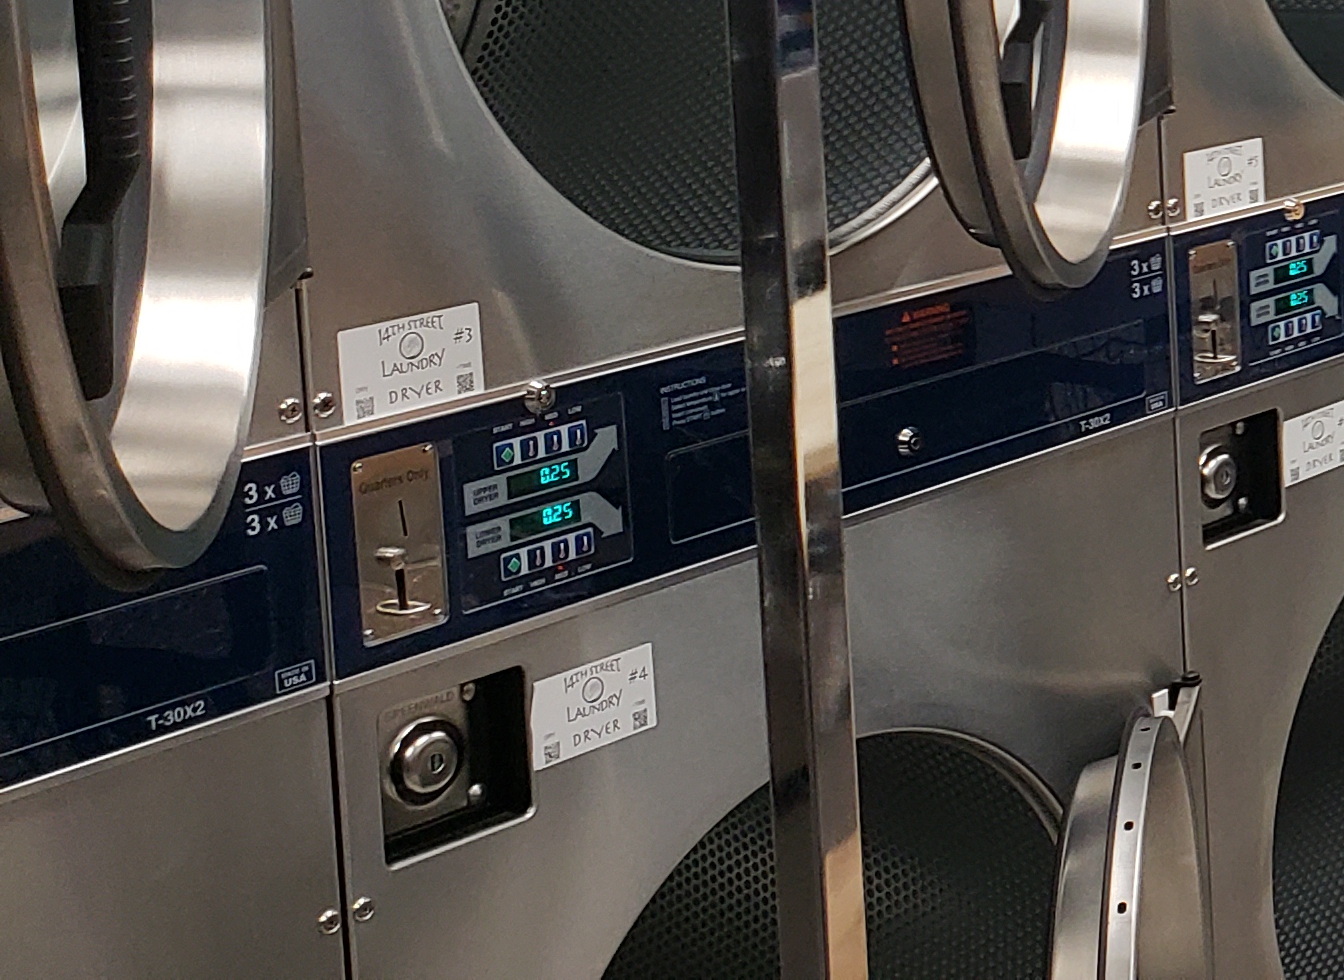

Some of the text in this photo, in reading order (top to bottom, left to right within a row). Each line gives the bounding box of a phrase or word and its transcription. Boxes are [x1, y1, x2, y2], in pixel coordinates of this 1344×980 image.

[1130, 260, 1140, 276] 3
[1131, 282, 1141, 299] 3
[378, 314, 444, 346] 14TH STREET
[453, 327, 473, 344] #3
[381, 347, 446, 378] LAUNDRY
[388, 379, 443, 405] DRYER
[242, 482, 276, 504] 3 x
[246, 513, 279, 536] 3 x
[284, 672, 307, 688] USA
[563, 657, 622, 694] 14TH STREET
[628, 666, 648, 684] #4
[146, 700, 207, 731] T-30X2
[566, 689, 623, 723] LAUNDRY
[572, 718, 621, 748] DRYER
